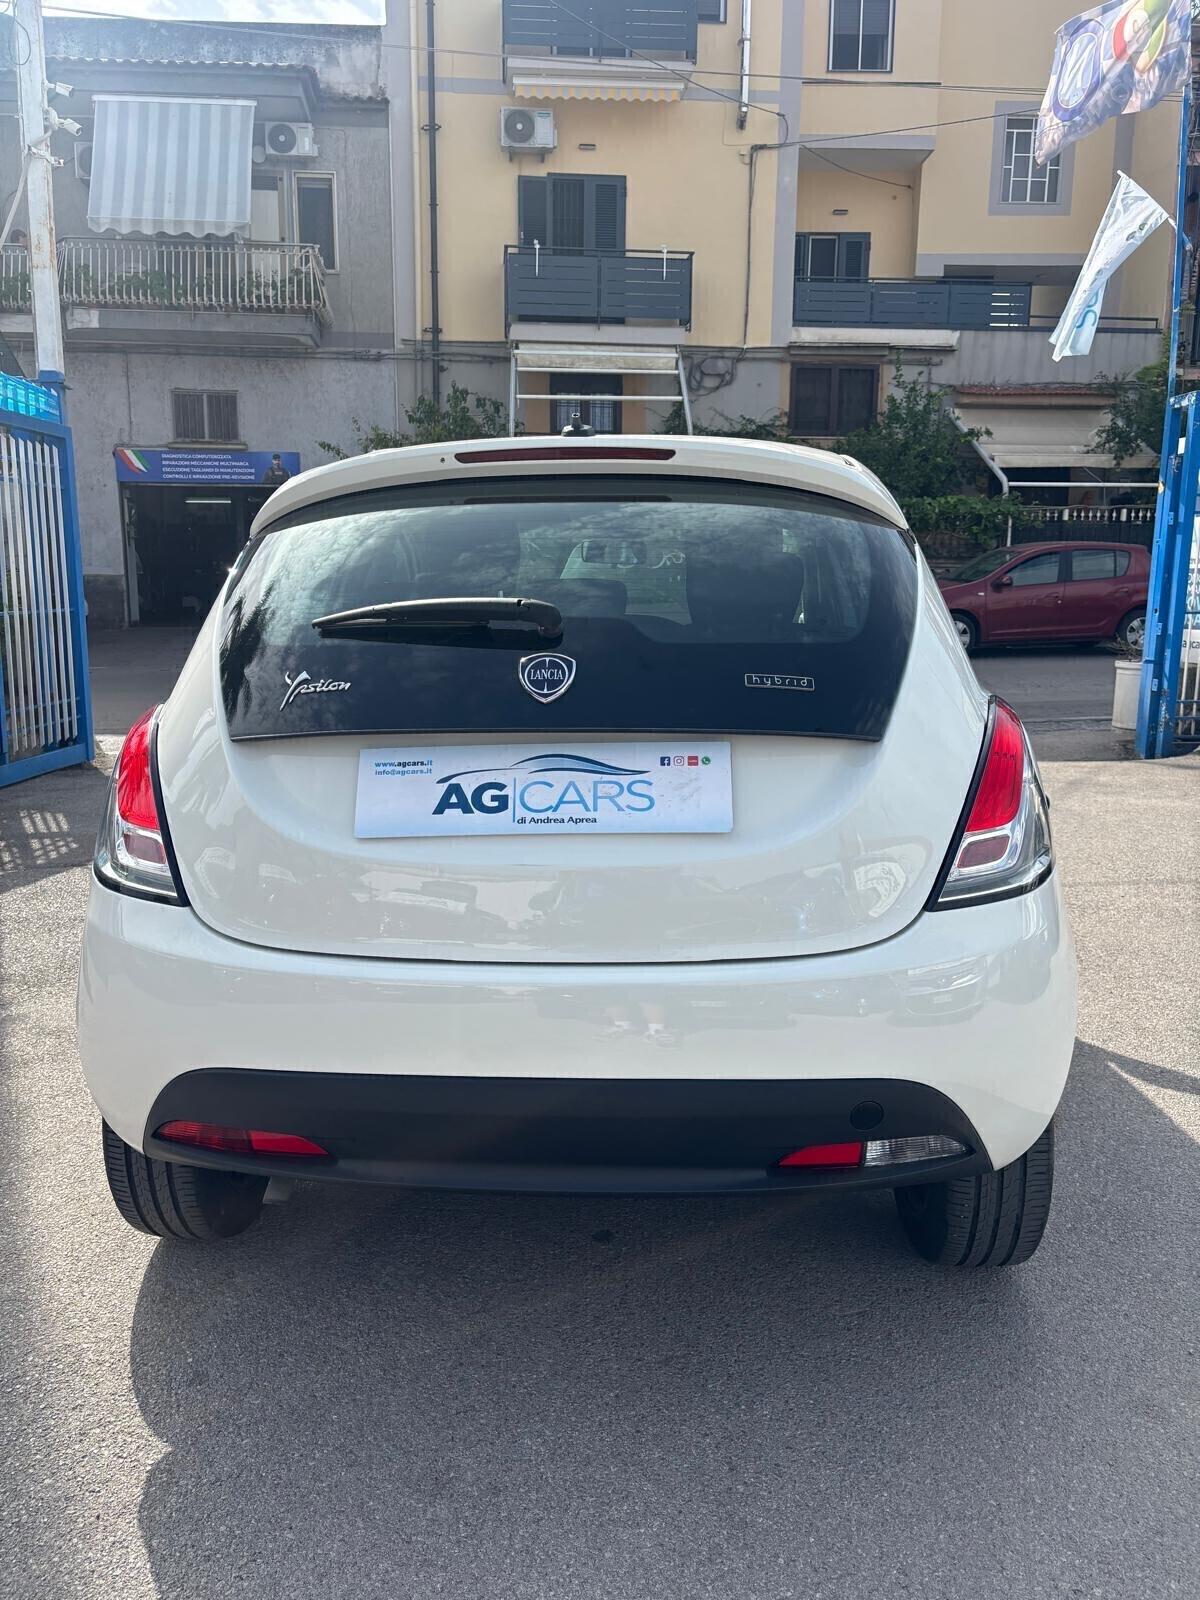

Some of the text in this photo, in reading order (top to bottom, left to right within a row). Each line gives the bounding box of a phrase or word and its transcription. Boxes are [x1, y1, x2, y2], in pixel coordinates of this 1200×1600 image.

[530, 669, 564, 680] LANCIA
[752, 675, 808, 687] hybrid
[280, 670, 352, 711] Ypsilon
[374, 759, 433, 768] www.agcars.it
[374, 767, 433, 776] info@agcars.it
[431, 779, 656, 815] AG CARS
[516, 815, 598, 826] di Andrea Aprea
